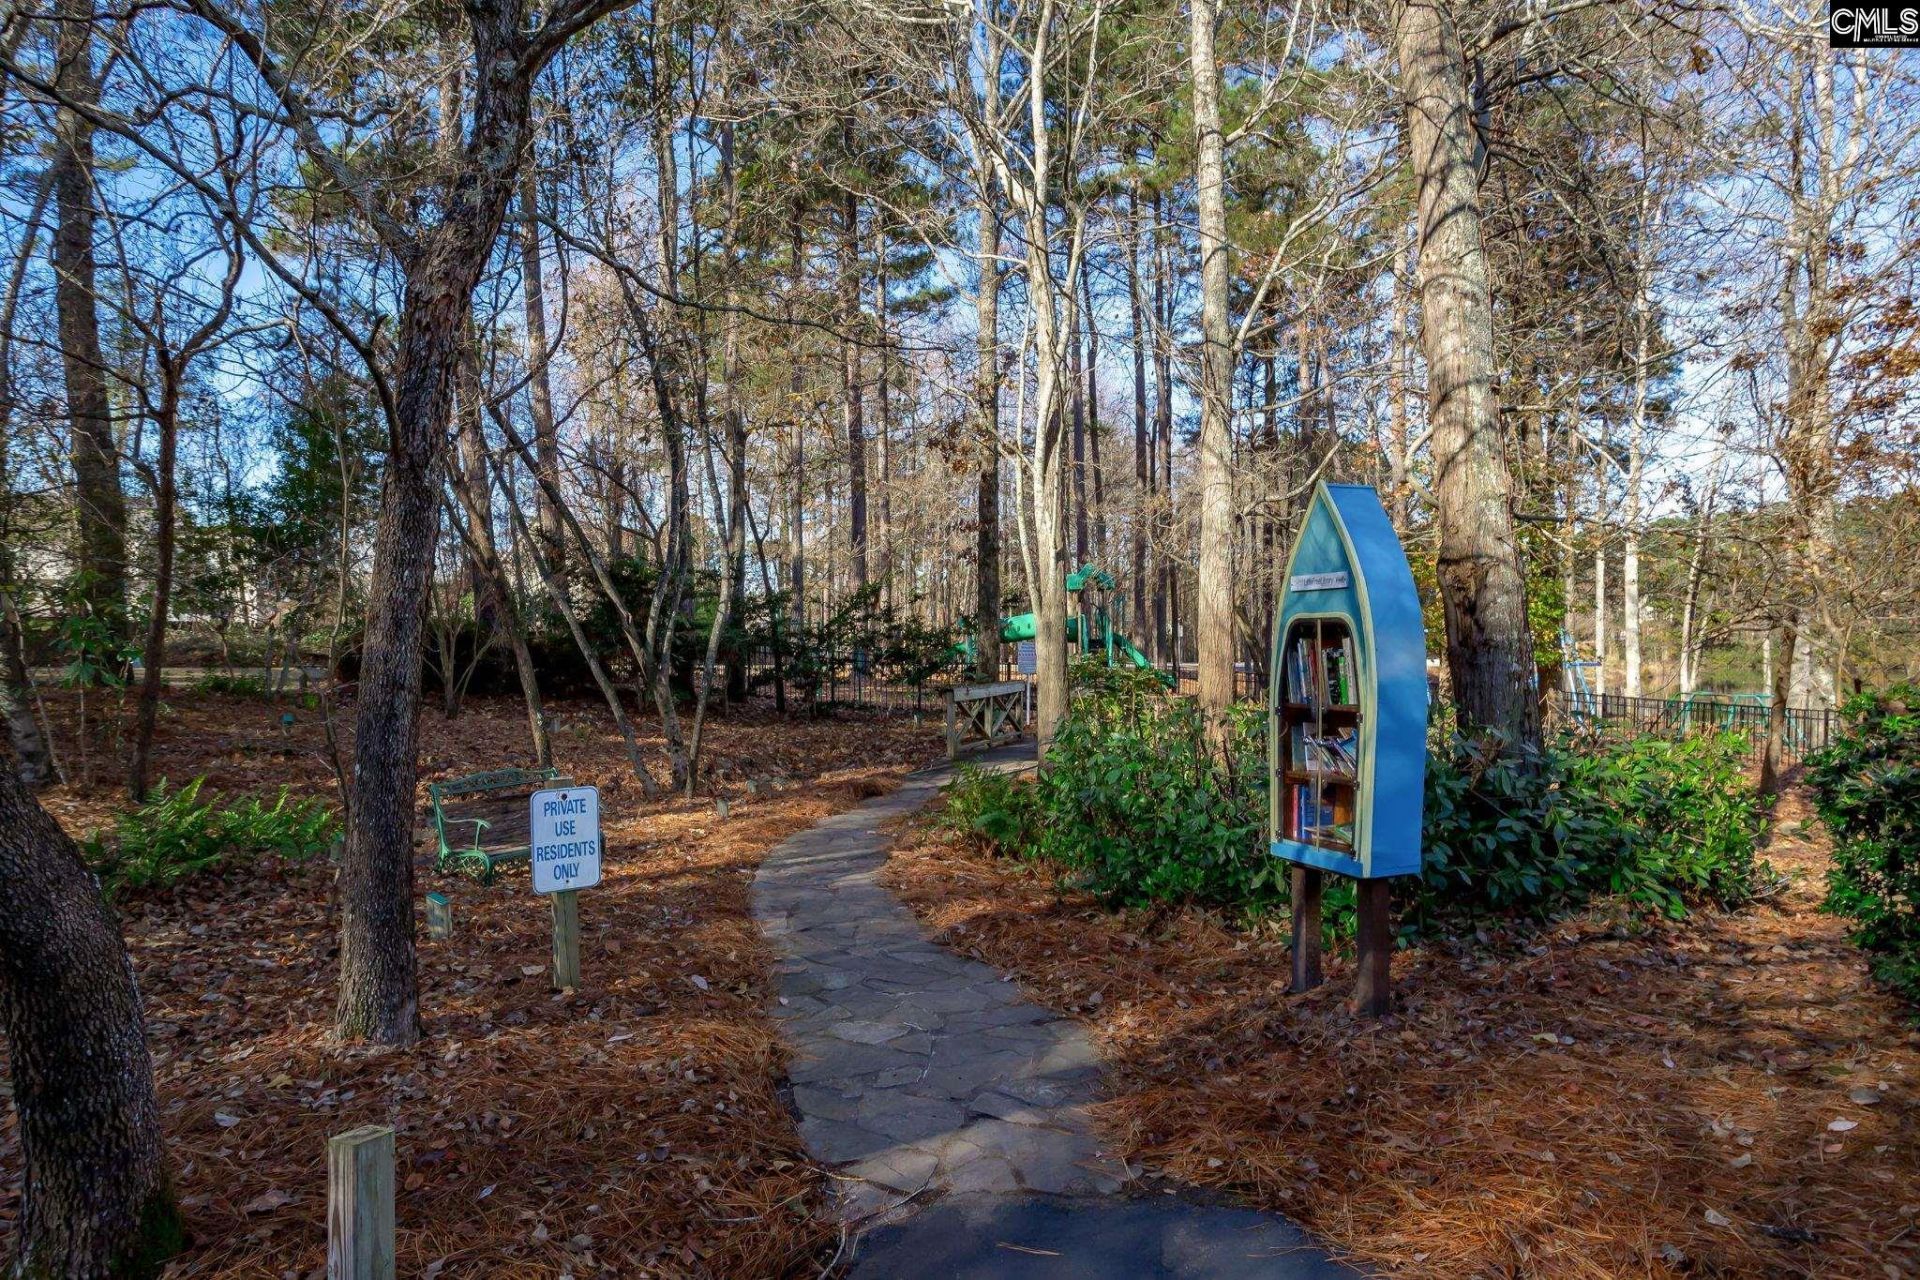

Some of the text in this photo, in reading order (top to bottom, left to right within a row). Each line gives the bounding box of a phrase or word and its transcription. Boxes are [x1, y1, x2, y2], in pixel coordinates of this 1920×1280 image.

[544, 799, 586, 816] PRIVATE
[555, 820, 576, 836] USE
[536, 841, 595, 862] RESIDENTS
[553, 863, 579, 880] ONLY
